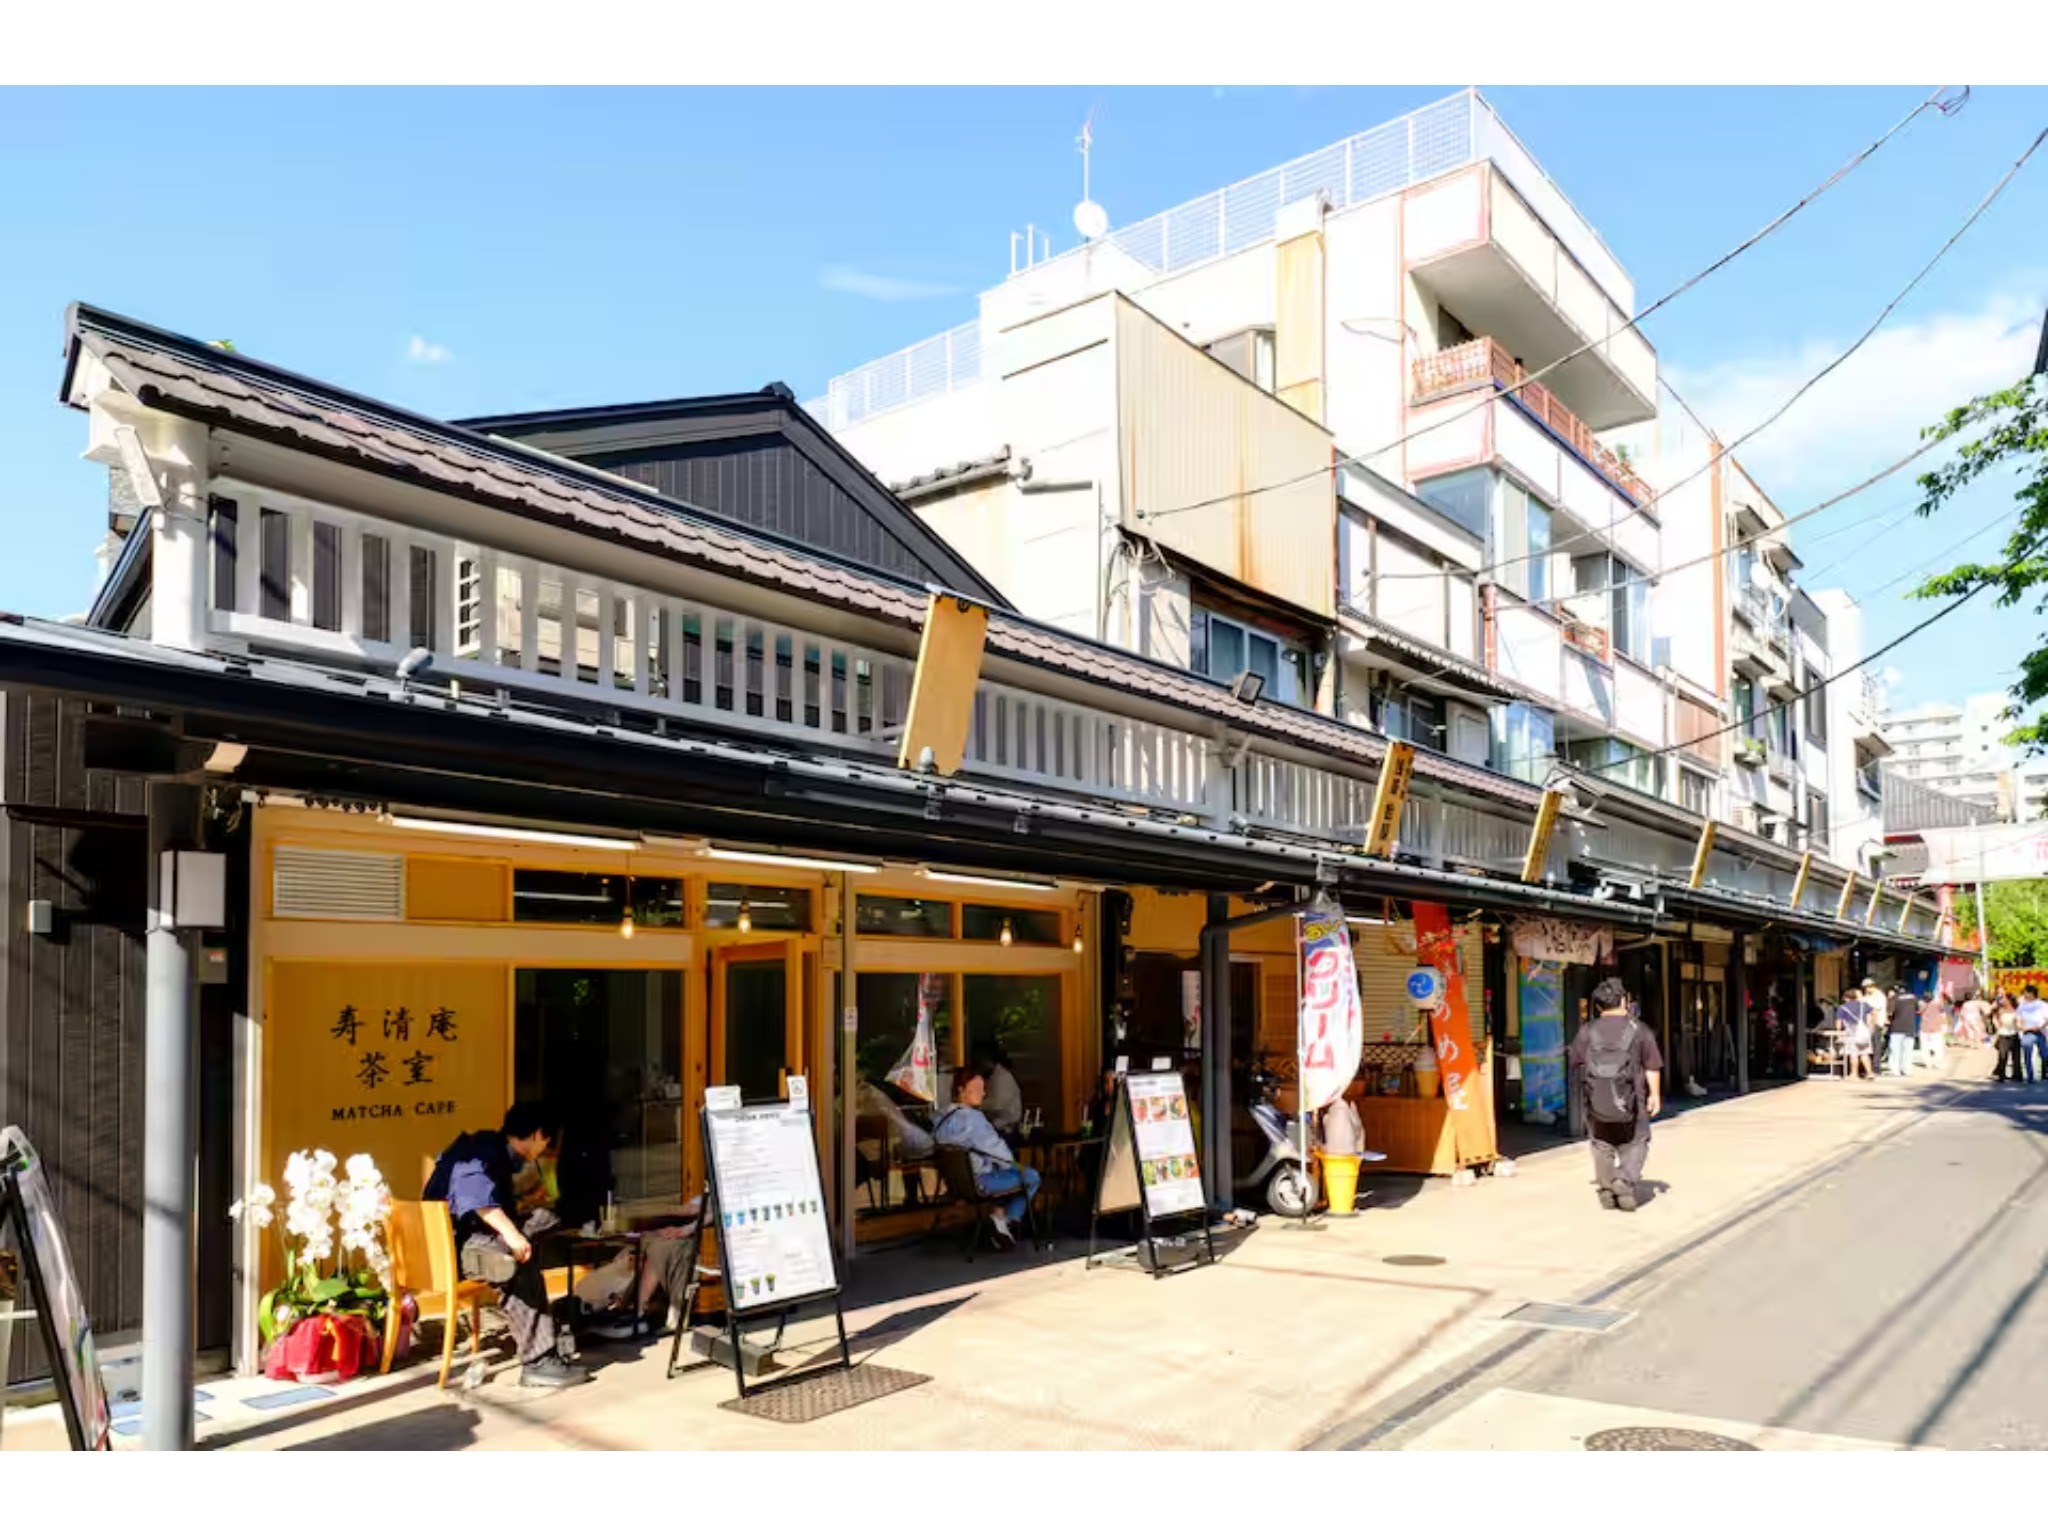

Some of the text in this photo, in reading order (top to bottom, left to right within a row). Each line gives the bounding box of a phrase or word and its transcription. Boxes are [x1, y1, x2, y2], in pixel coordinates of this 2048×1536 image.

[330, 1004, 458, 1046] 寿清庵
[1305, 951, 1340, 1070] クリーム
[355, 1050, 435, 1089] 茶室
[331, 1100, 457, 1121] MATCHA CAFE
